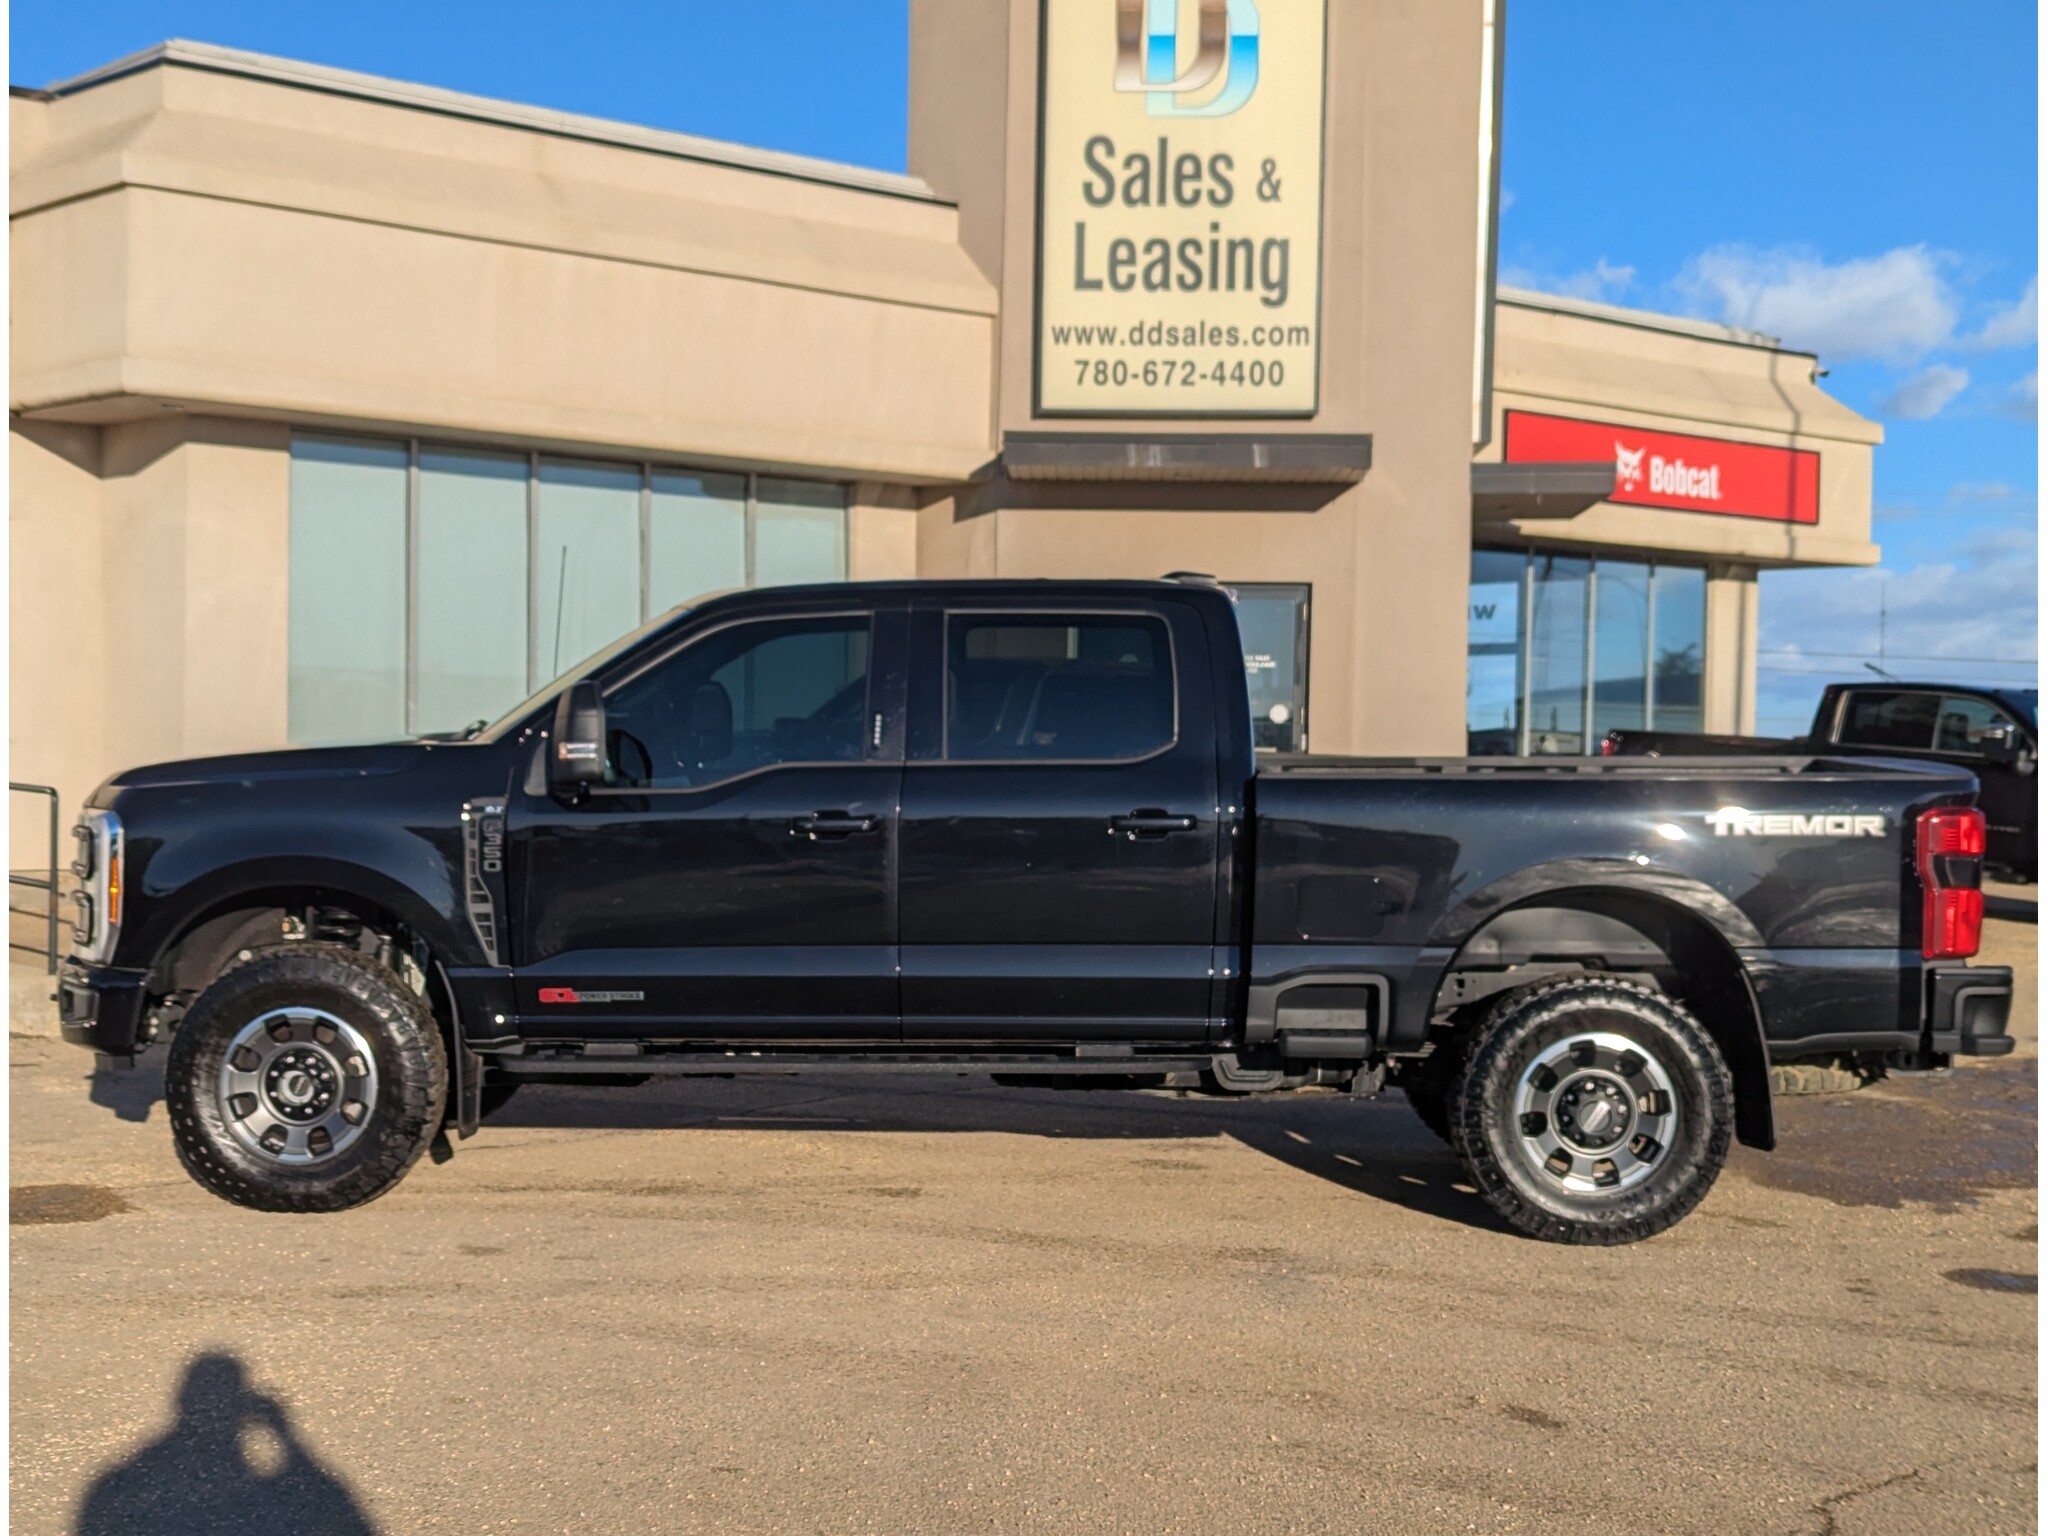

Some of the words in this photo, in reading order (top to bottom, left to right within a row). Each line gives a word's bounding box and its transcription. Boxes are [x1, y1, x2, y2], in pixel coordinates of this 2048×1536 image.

[1082, 135, 1234, 208] Sales
[1256, 158, 1282, 202] &
[1073, 222, 1290, 308] Leasing
[1051, 321, 1310, 347] www.ddsales.com
[1073, 360, 1285, 387] 780-672-4400
[1649, 455, 1721, 500] Bobcat
[1704, 812, 1886, 837] TREMOR
